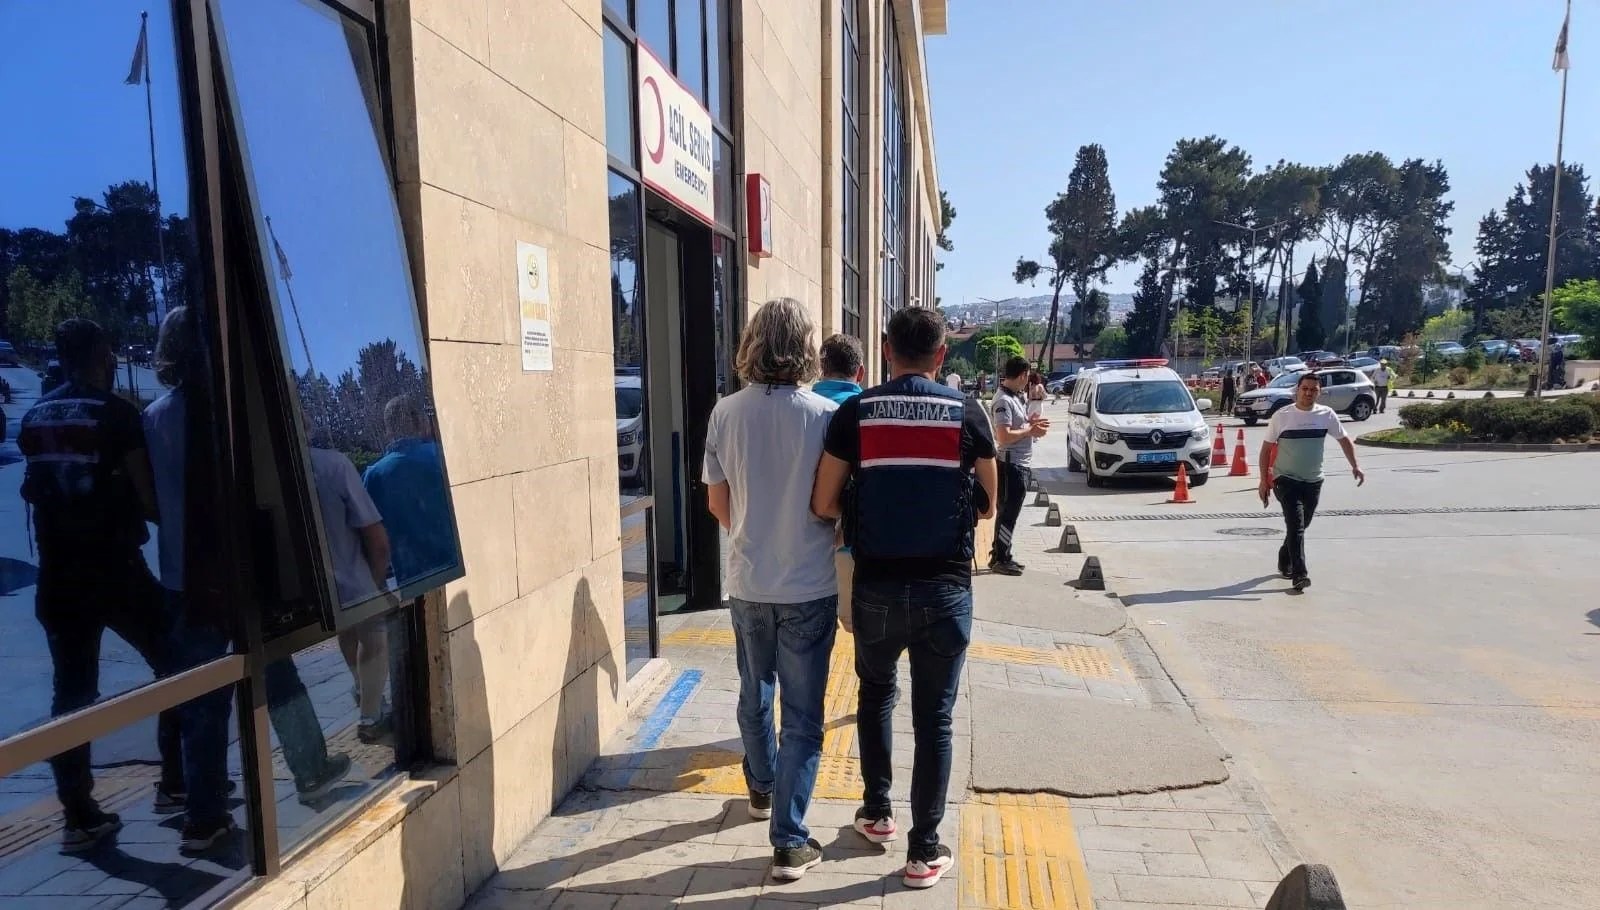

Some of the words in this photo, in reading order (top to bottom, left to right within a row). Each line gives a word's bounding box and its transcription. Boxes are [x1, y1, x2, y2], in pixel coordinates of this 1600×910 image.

[669, 103, 687, 152] ACİL
[689, 121, 711, 172] SERVİS
[867, 400, 951, 420] JANDARMA
